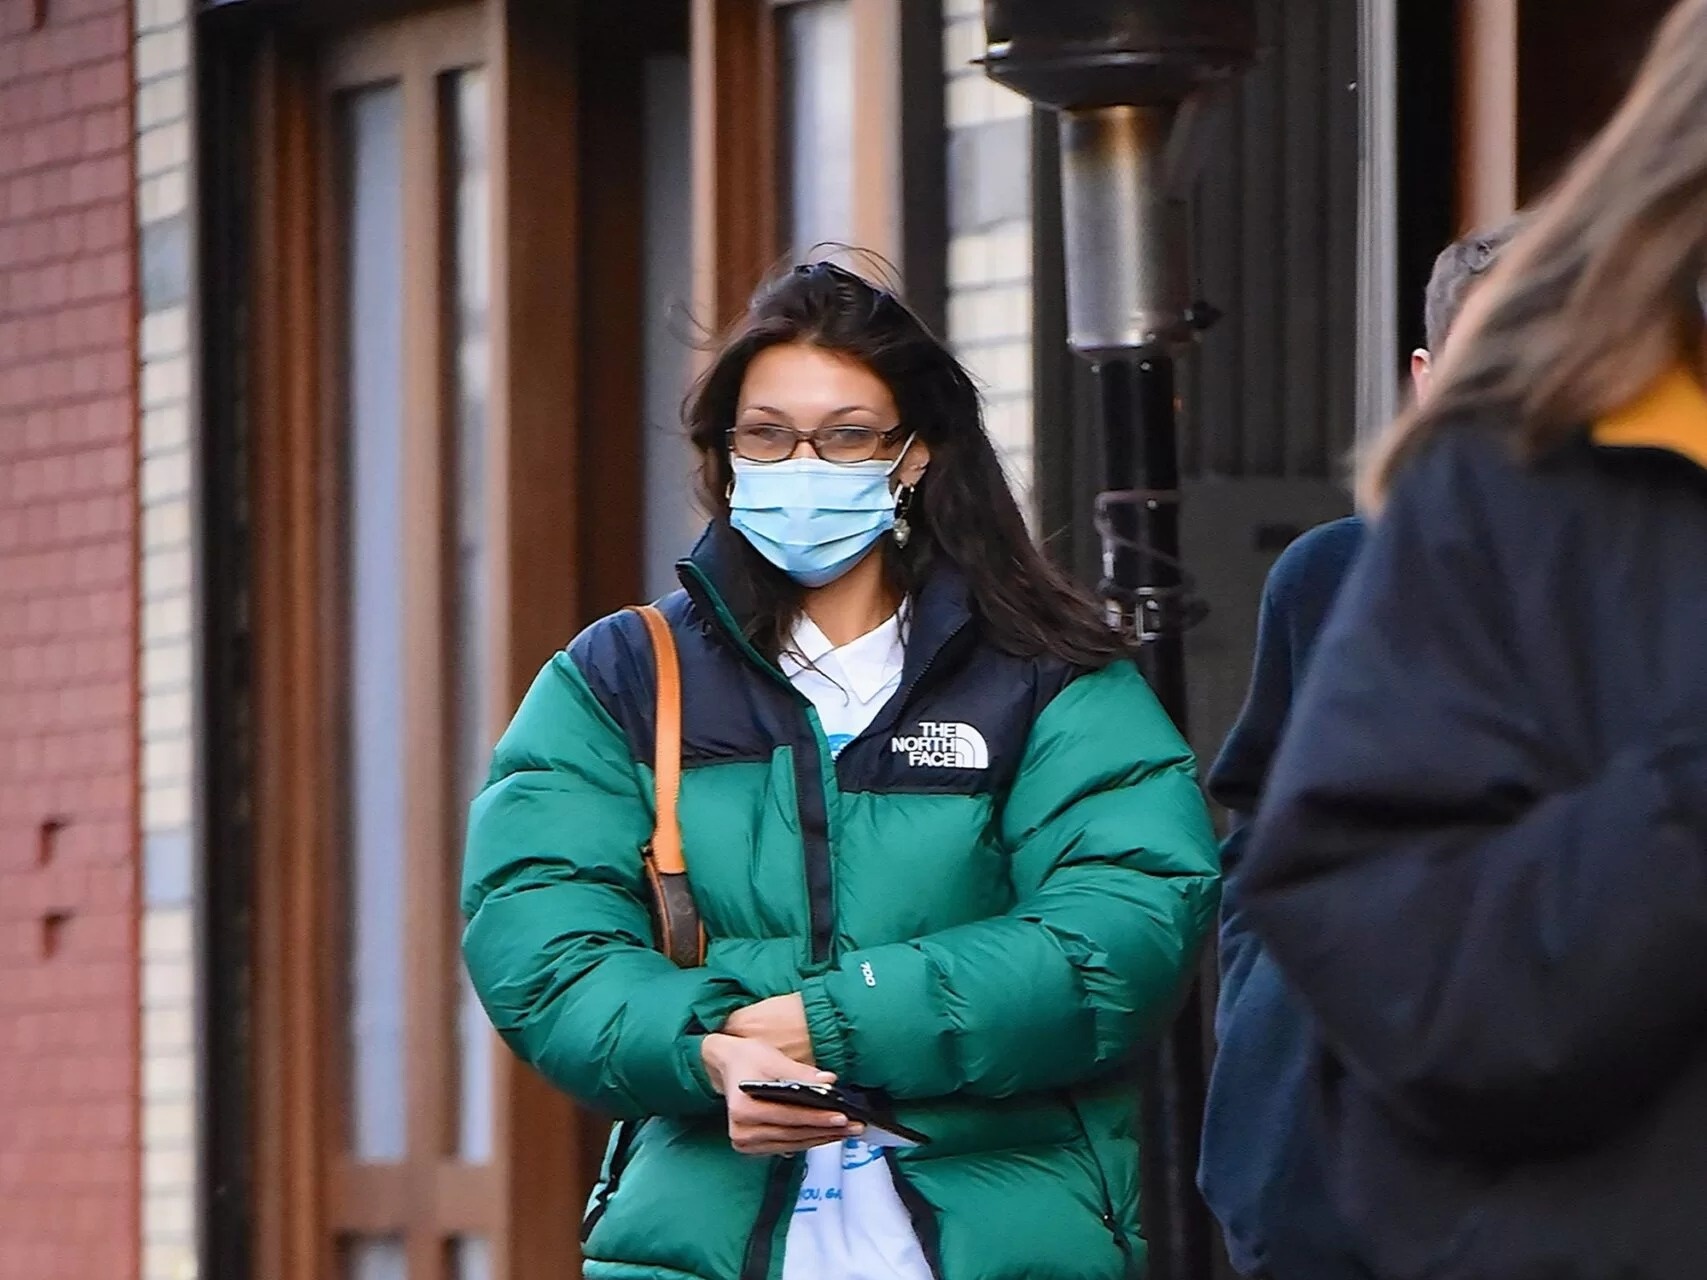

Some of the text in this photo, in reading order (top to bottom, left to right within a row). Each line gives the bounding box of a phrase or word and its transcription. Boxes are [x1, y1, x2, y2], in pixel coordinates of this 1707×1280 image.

[918, 722, 956, 737] THE
[891, 737, 955, 752] NORTH
[909, 752, 956, 767] FACE
[860, 961, 876, 986] 700
